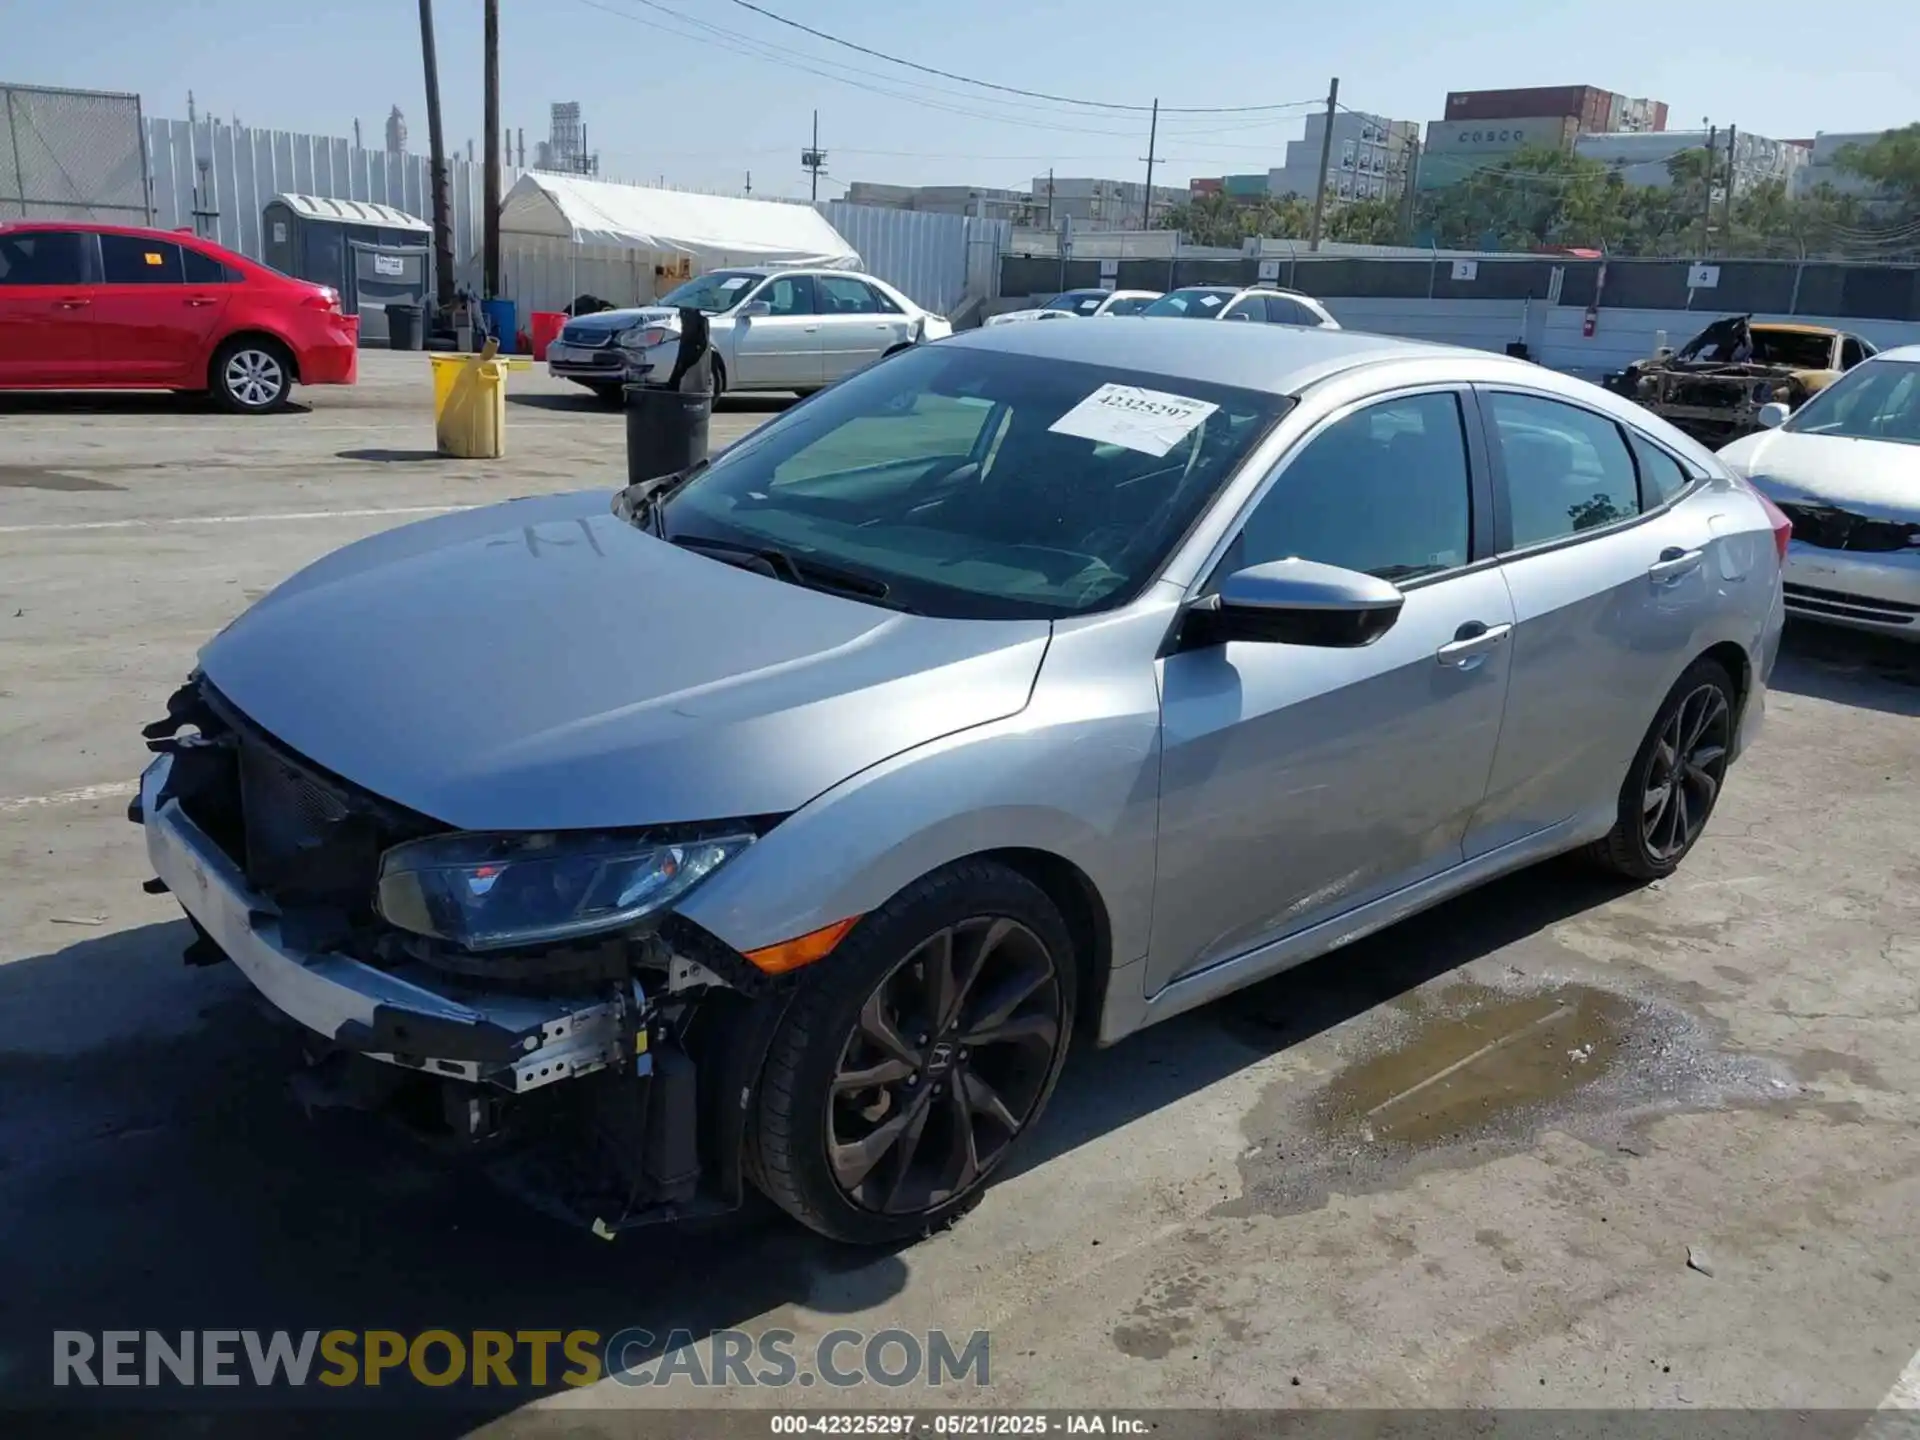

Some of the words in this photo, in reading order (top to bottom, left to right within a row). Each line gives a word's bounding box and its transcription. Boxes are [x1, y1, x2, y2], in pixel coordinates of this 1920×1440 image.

[1458, 129, 1524, 143] COSCO
[1461, 265, 1468, 276] 3
[1698, 271, 1708, 282] 4
[1098, 393, 1192, 420] 42325297
